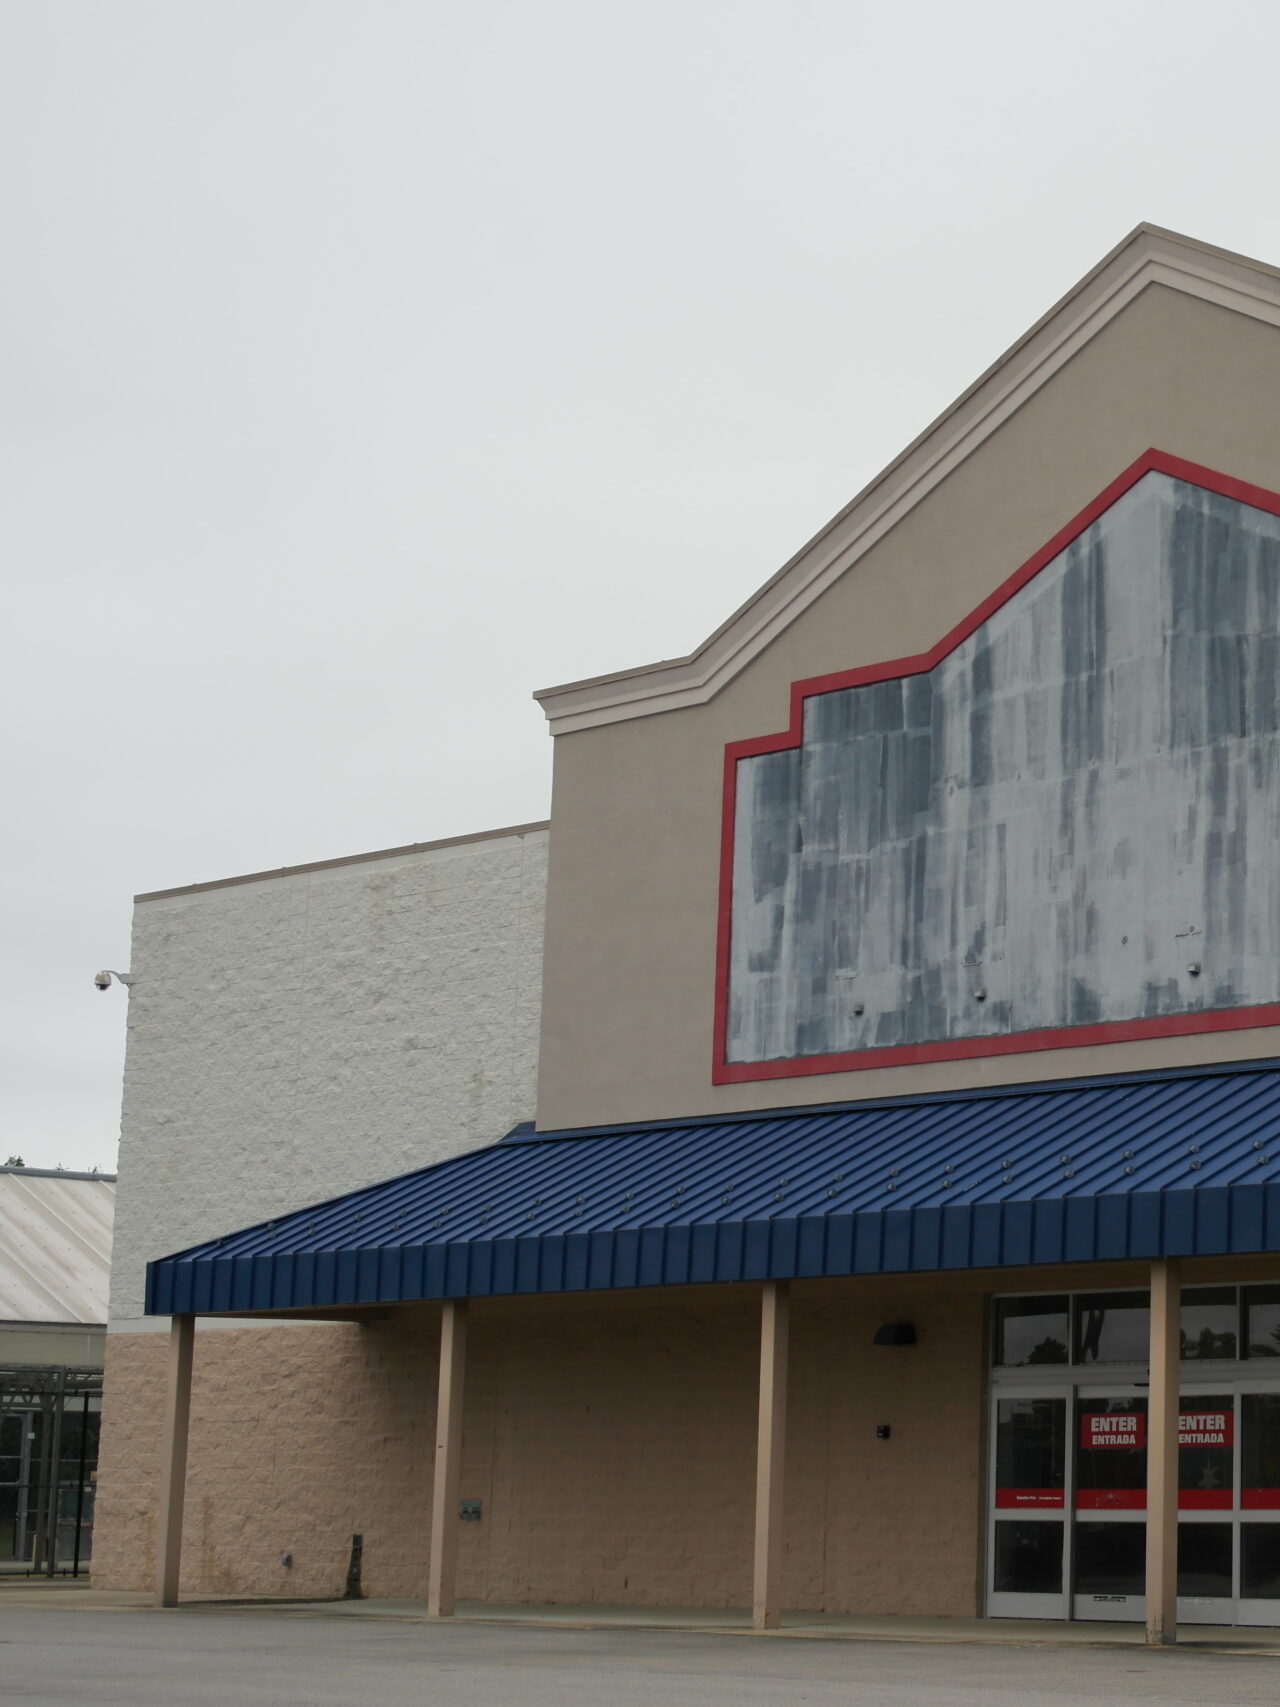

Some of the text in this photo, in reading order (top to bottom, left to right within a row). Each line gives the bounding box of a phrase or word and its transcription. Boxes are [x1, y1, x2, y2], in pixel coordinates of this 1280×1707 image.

[1091, 1417, 1136, 1432] ENTER
[1178, 1415, 1225, 1430] ENTER
[1092, 1434, 1136, 1445] ENTRADA
[1178, 1433, 1224, 1443] ENTRADA
